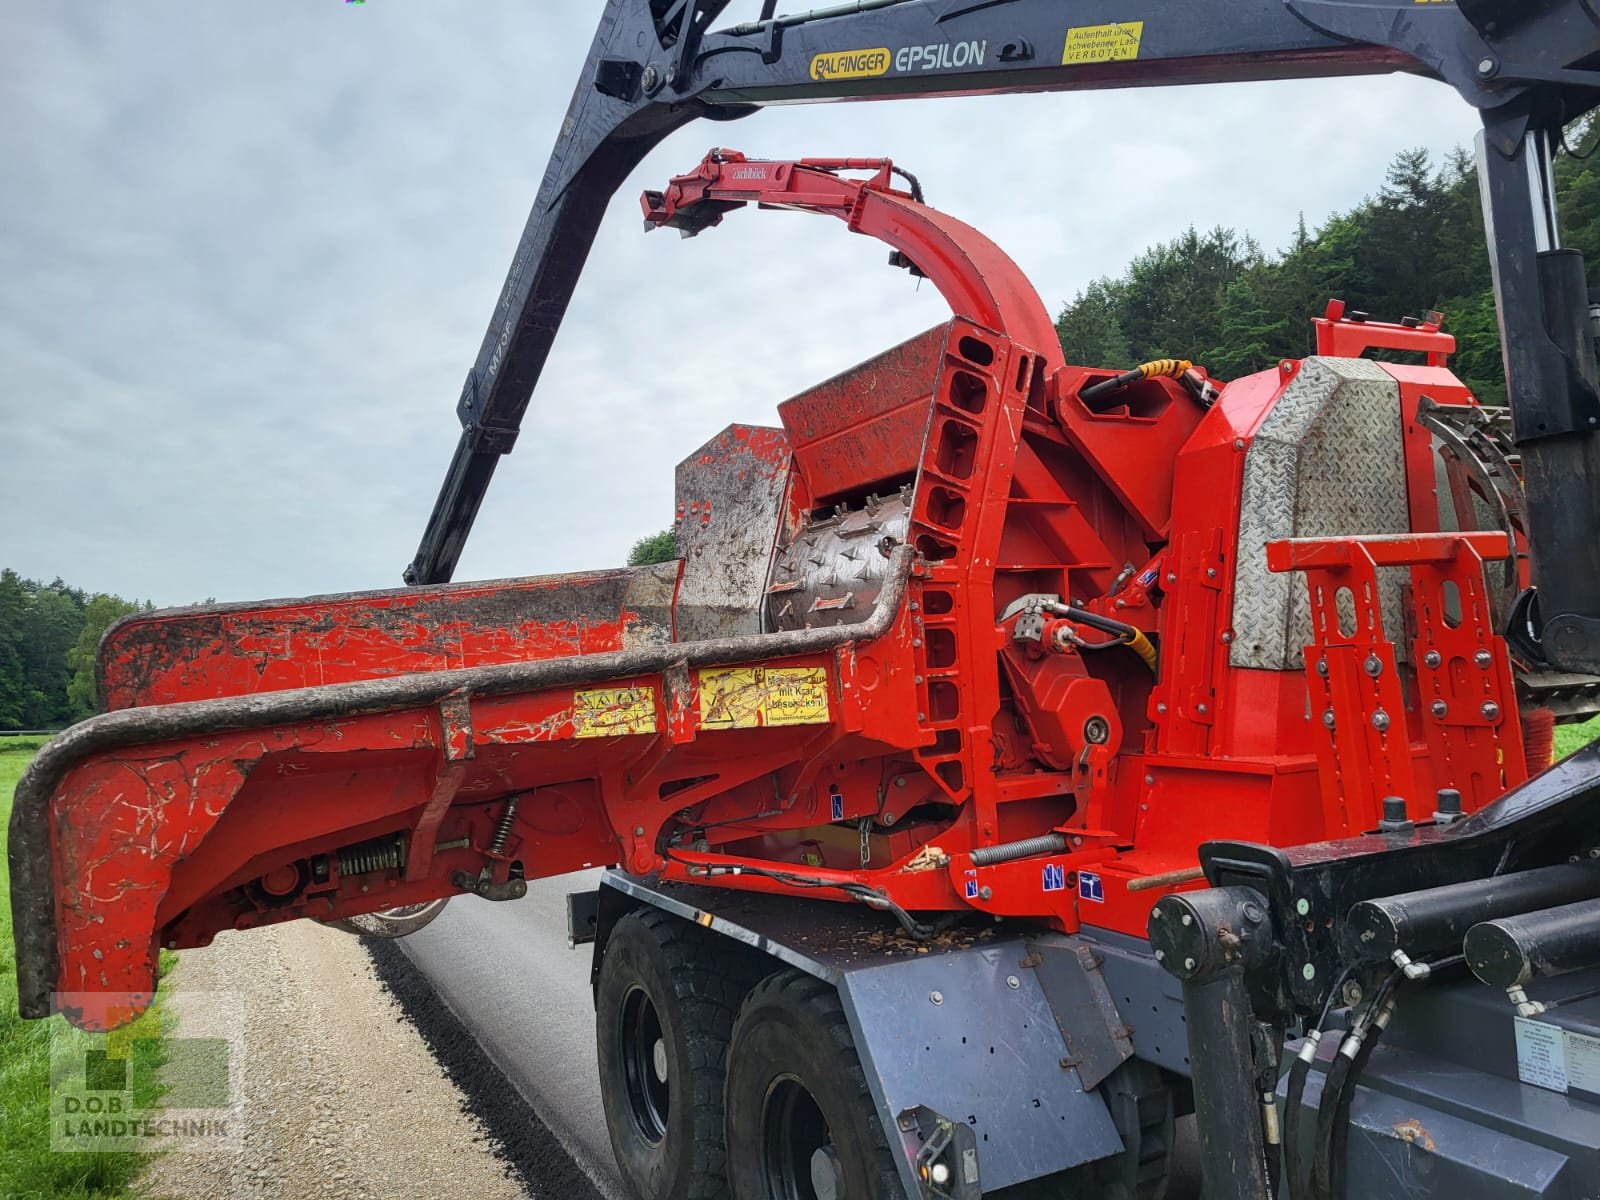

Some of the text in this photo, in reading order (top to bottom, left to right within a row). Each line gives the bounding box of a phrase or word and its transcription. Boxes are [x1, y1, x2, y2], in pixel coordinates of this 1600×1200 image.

[1073, 29, 1113, 40] Aufenthalt
[1068, 38, 1138, 50] schwebender Last
[815, 39, 987, 76] PALFINGER EPSILON
[1068, 47, 1133, 60] VERBOTEN!
[779, 687, 793, 697] mit
